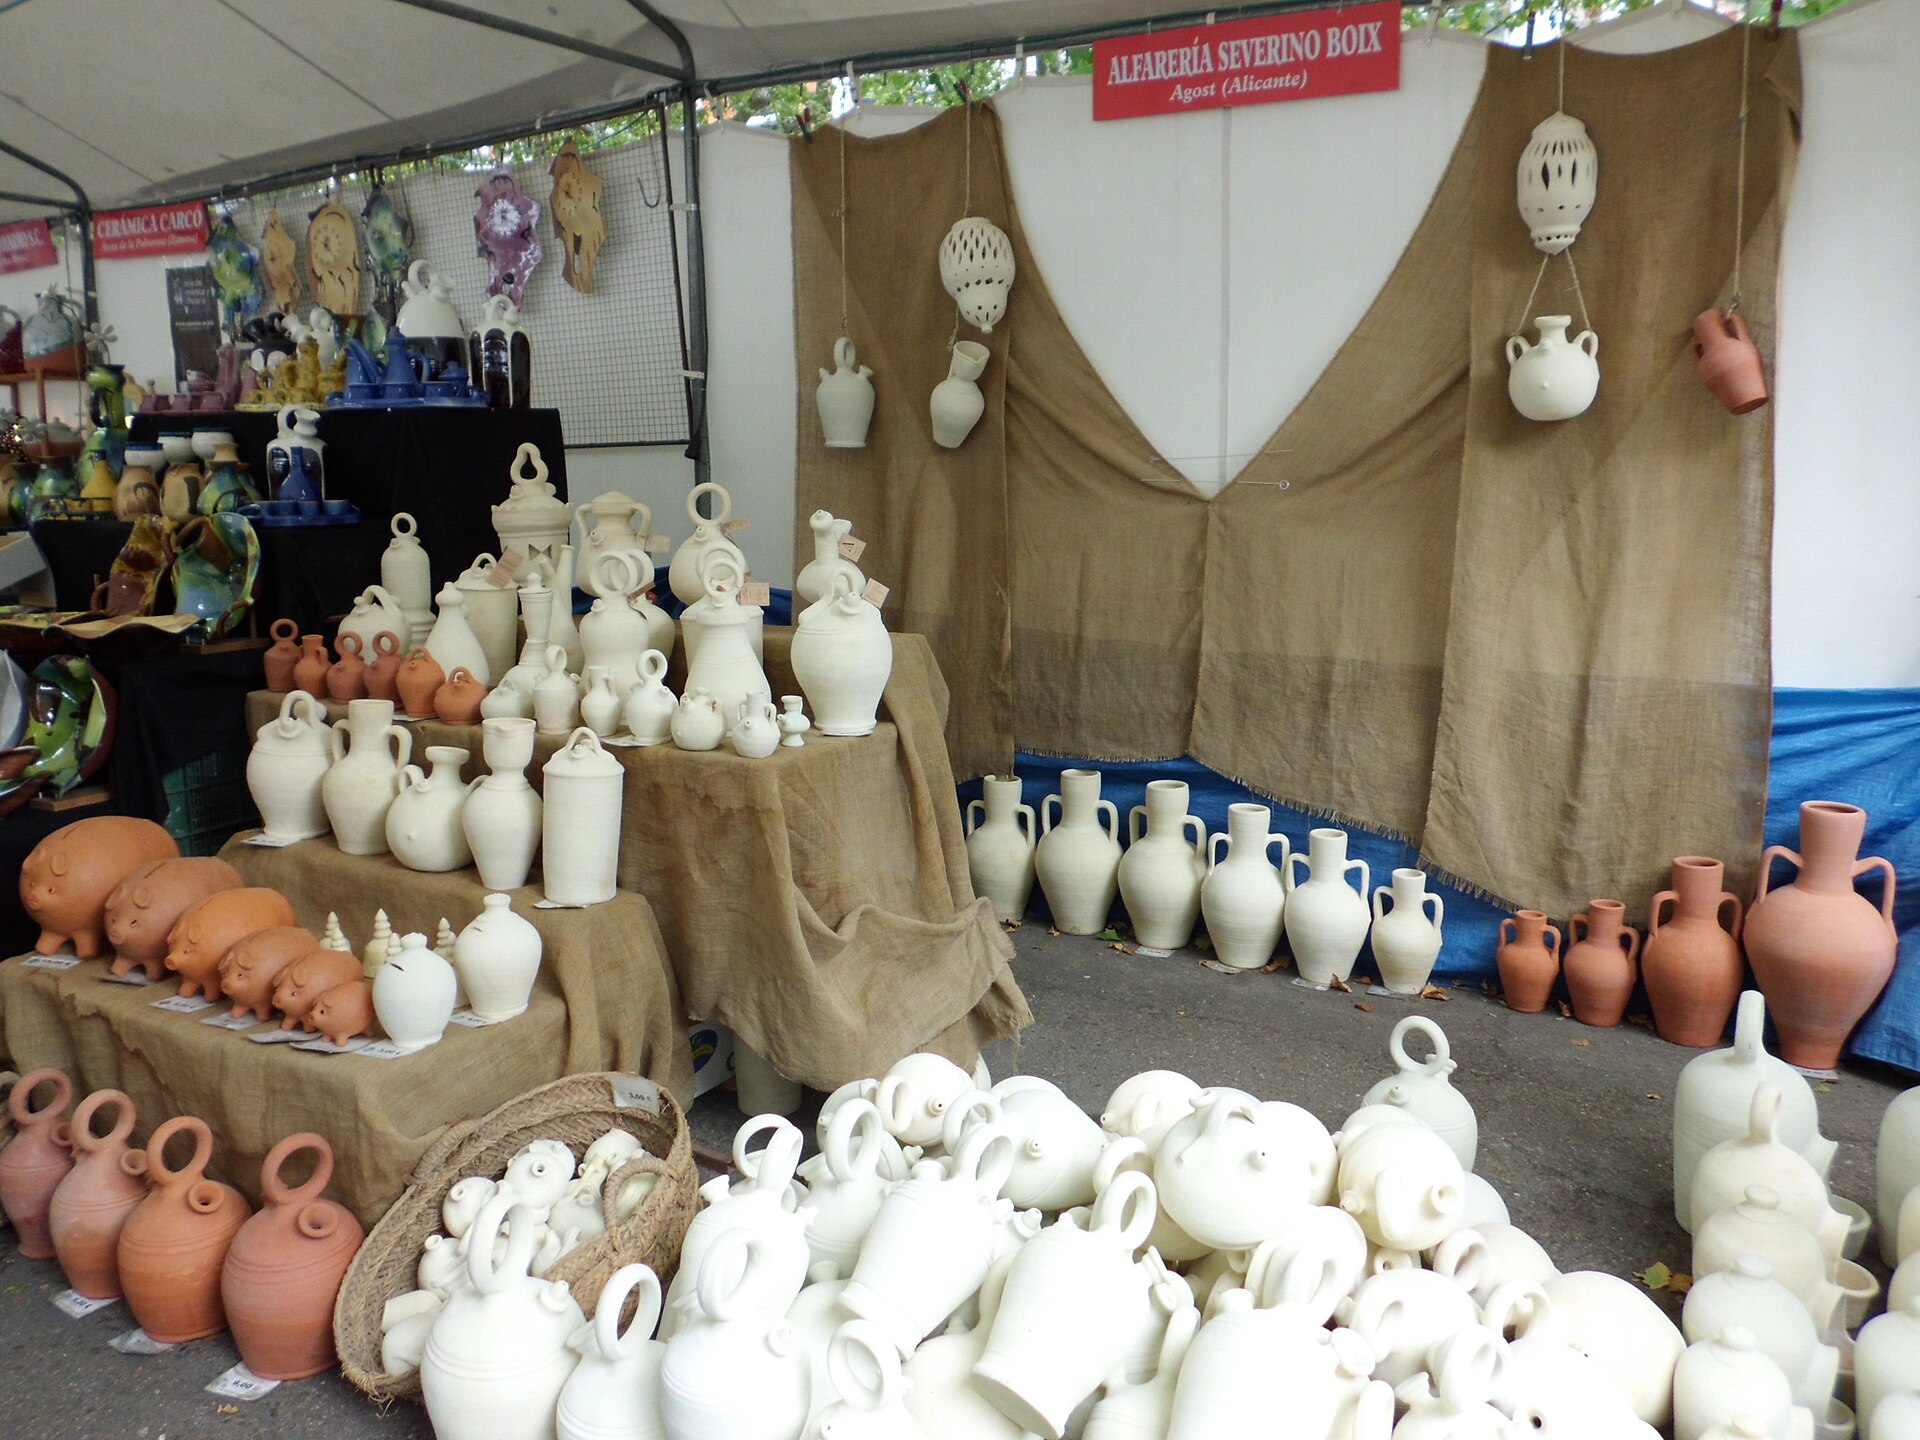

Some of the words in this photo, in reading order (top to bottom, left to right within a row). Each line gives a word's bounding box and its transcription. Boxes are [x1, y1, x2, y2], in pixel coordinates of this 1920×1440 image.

[1107, 36, 1214, 85] ALFARERÍA
[1218, 29, 1321, 71] SEVERINO
[1326, 21, 1382, 58] BOIX
[1169, 82, 1216, 103] Agost
[1222, 69, 1308, 98] (Alicante)
[97, 213, 158, 238] CERÁMICA
